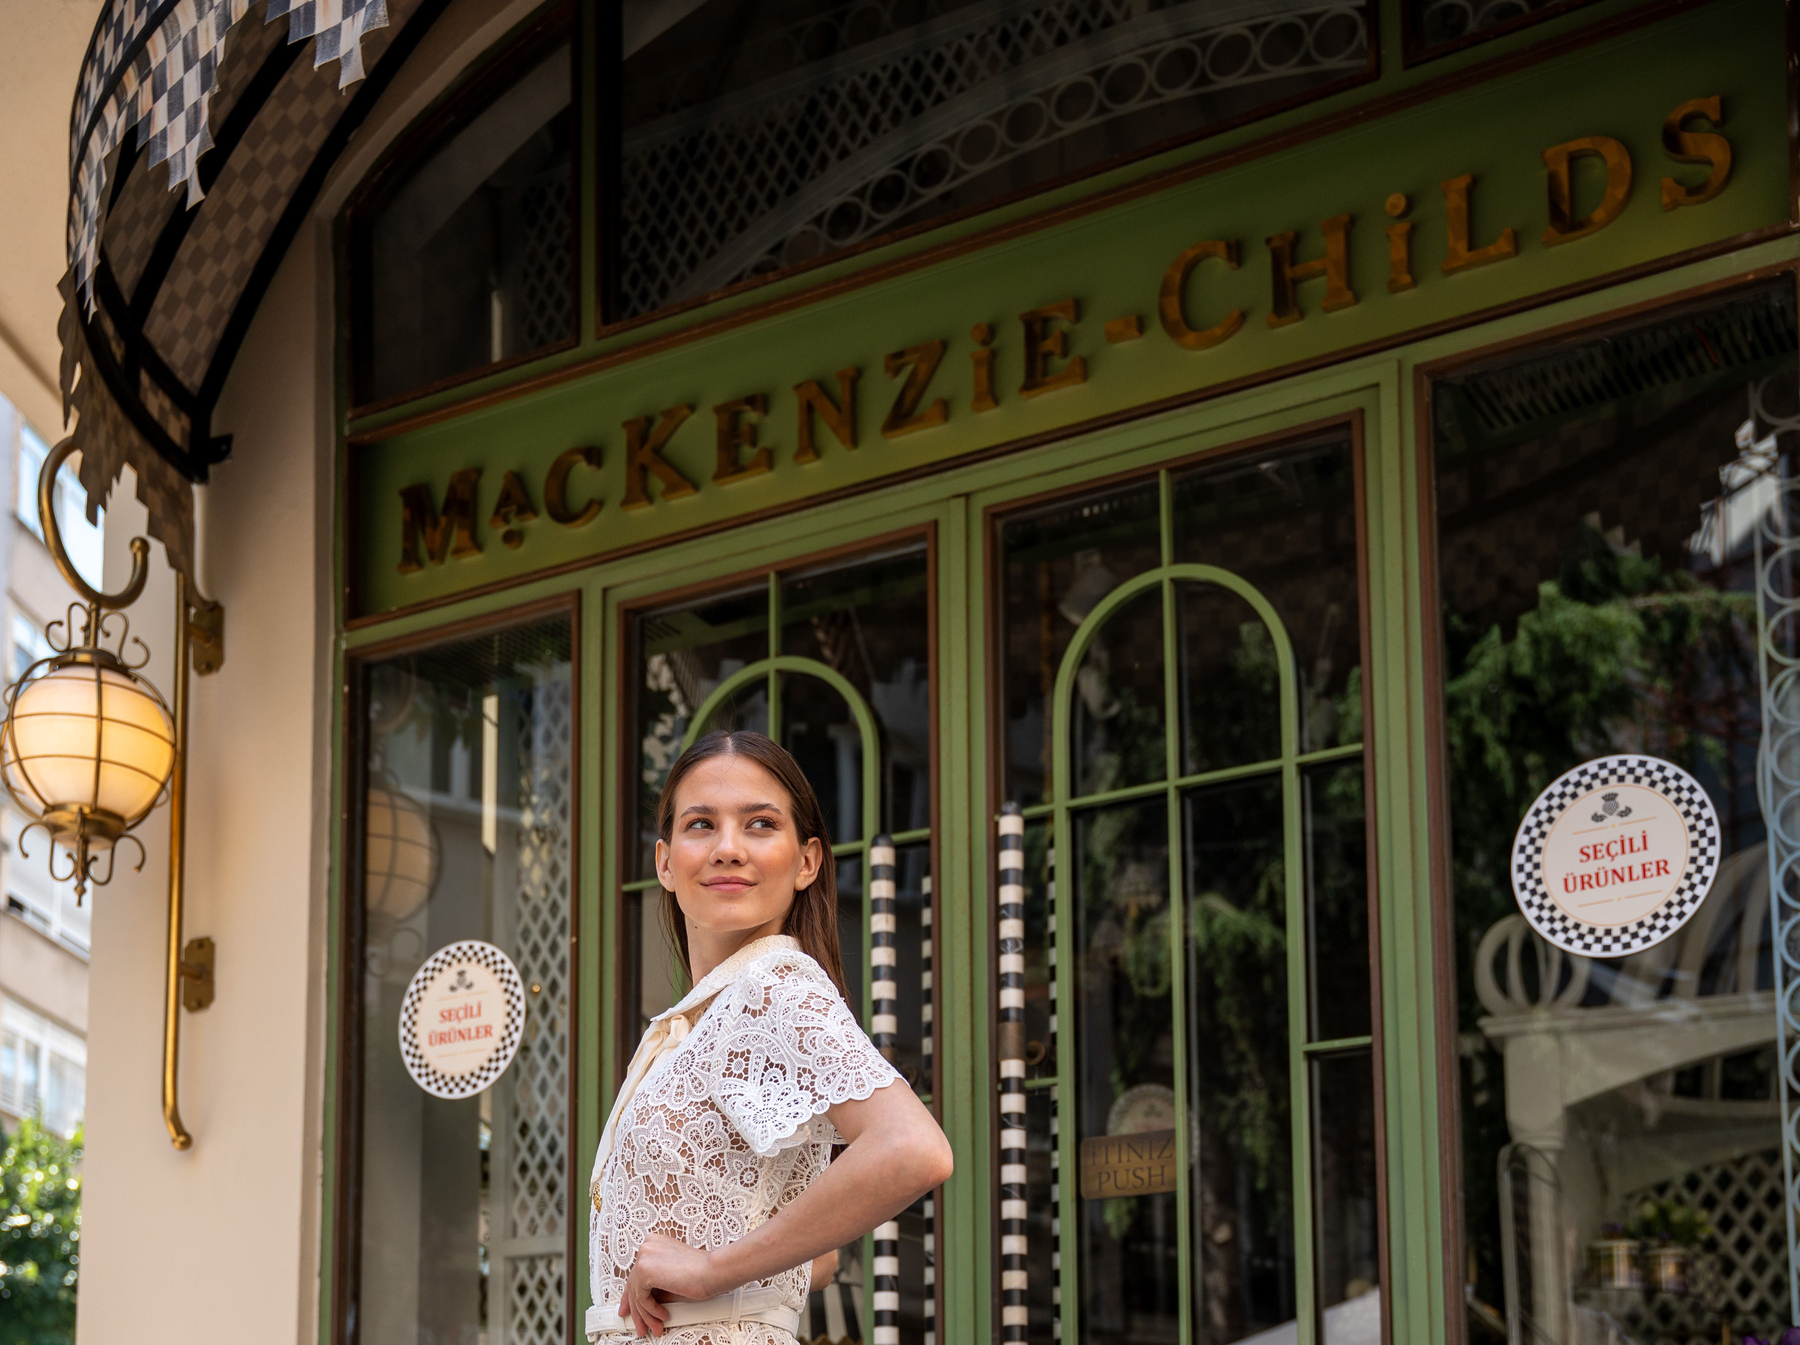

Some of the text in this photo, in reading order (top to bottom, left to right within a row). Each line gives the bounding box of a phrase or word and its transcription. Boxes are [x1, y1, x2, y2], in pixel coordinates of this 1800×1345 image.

[1578, 830, 1649, 864] SEÇİLİ
[1562, 858, 1671, 894] ÜRÜNLER
[439, 1001, 482, 1024] SEÇİLİ
[428, 1024, 493, 1047] ÜRÜNLER
[1097, 1164, 1165, 1192] PUSH
